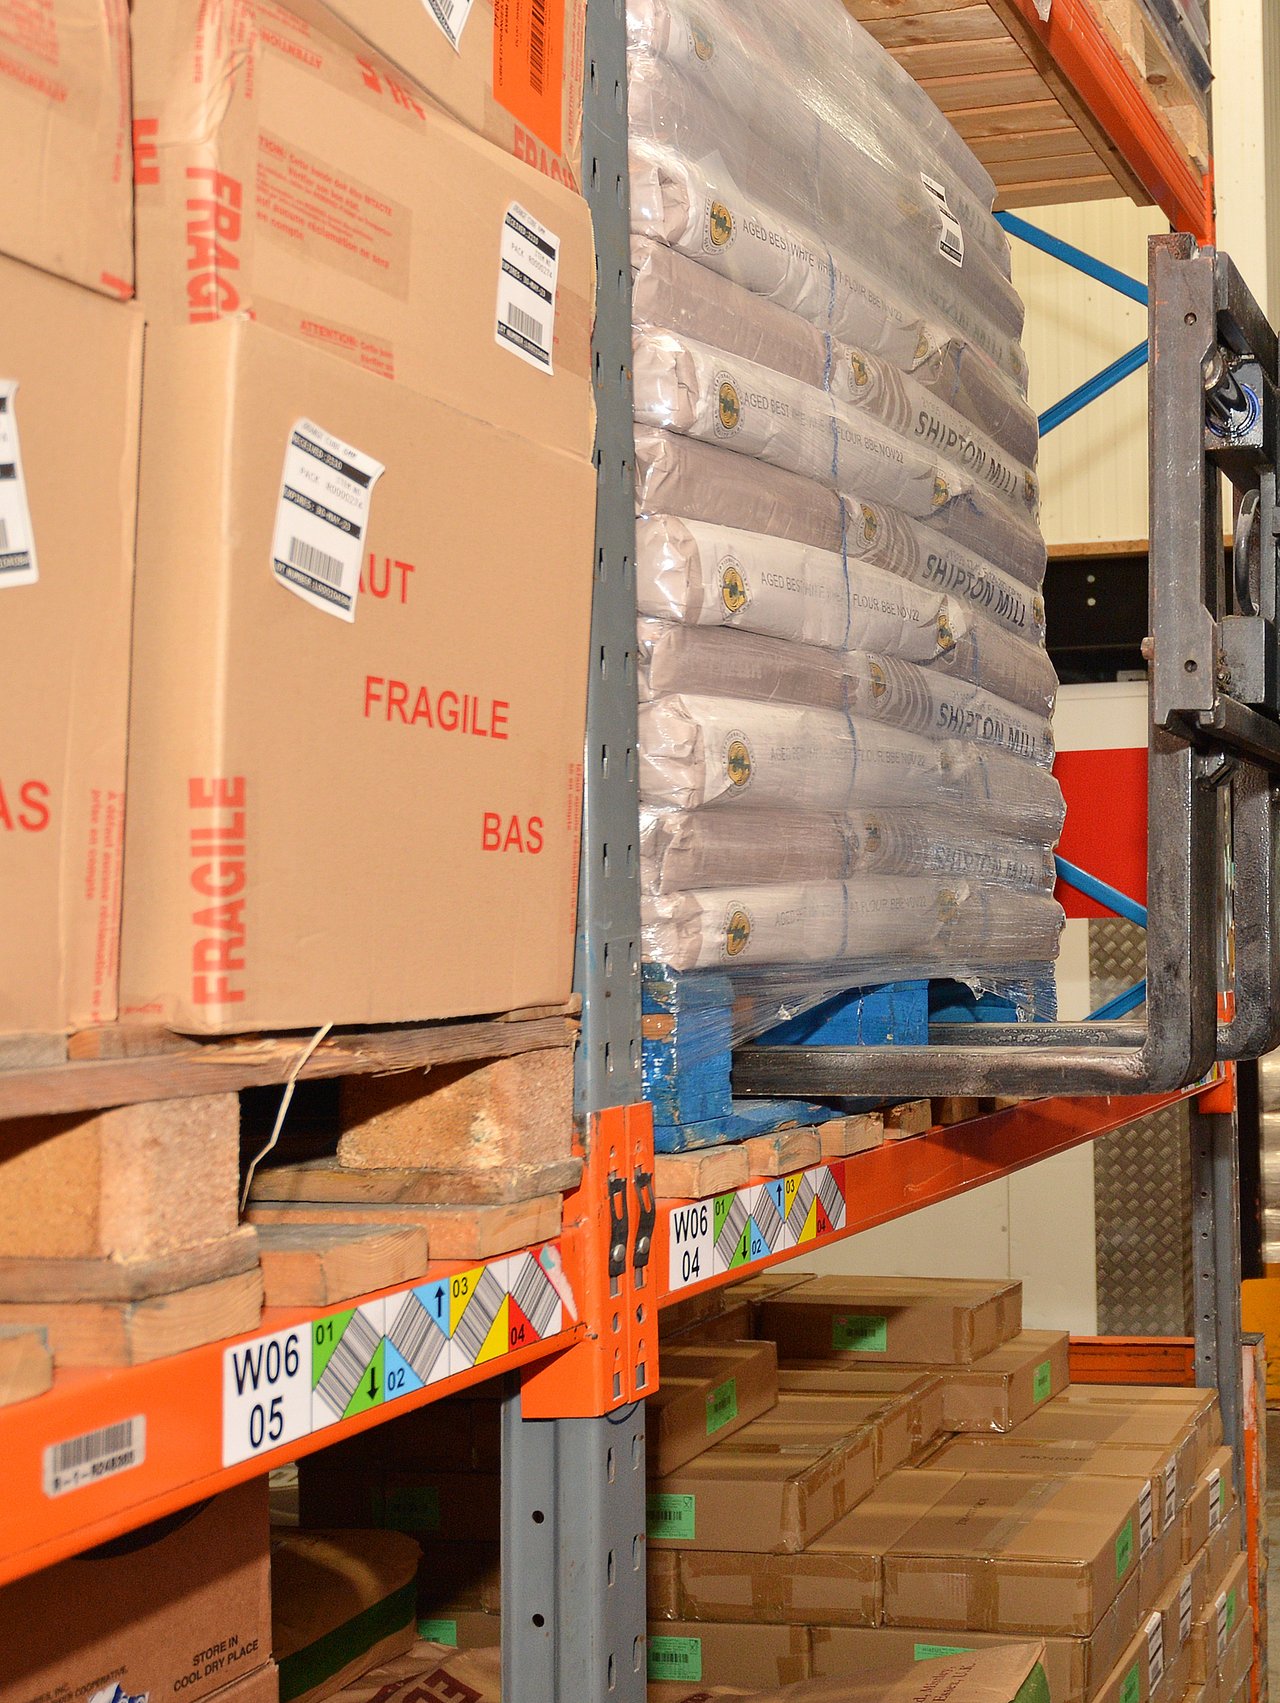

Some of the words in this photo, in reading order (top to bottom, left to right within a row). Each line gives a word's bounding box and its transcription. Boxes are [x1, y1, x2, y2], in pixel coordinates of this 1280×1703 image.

[743, 218, 768, 242] AGED
[744, 392, 770, 411] AGED
[770, 399, 791, 418] BEST
[838, 425, 862, 447] FLOUR
[914, 410, 987, 475] SHIPTON
[985, 457, 1018, 497] MILL
[761, 571, 785, 588] AGED
[853, 593, 879, 611] FLOUR
[922, 554, 995, 608] SHIPTON
[993, 589, 1026, 628] MILL
[364, 674, 511, 740] FRAGILE
[936, 702, 1004, 745] SHIPTON
[1007, 726, 1036, 759] MILL
[481, 811, 545, 855] BAS
[188, 776, 247, 1006] FRAGILE
[715, 1198, 727, 1217] 01
[785, 1178, 796, 1195] 03
[674, 1205, 709, 1244] W06
[750, 1239, 763, 1256] 02
[816, 1217, 827, 1233] 04
[681, 1245, 702, 1283] 04
[315, 1323, 335, 1347] 01
[452, 1276, 470, 1299] 03
[232, 1333, 301, 1397] W06
[387, 1370, 406, 1392] 02
[510, 1325, 527, 1345] 04
[248, 1397, 286, 1450] 05
[173, 1671, 203, 1692] COOL
[204, 1656, 225, 1678] DRY
[227, 1639, 259, 1667] PLACE
[192, 1642, 228, 1667] STORE
[228, 1635, 239, 1649] IN
